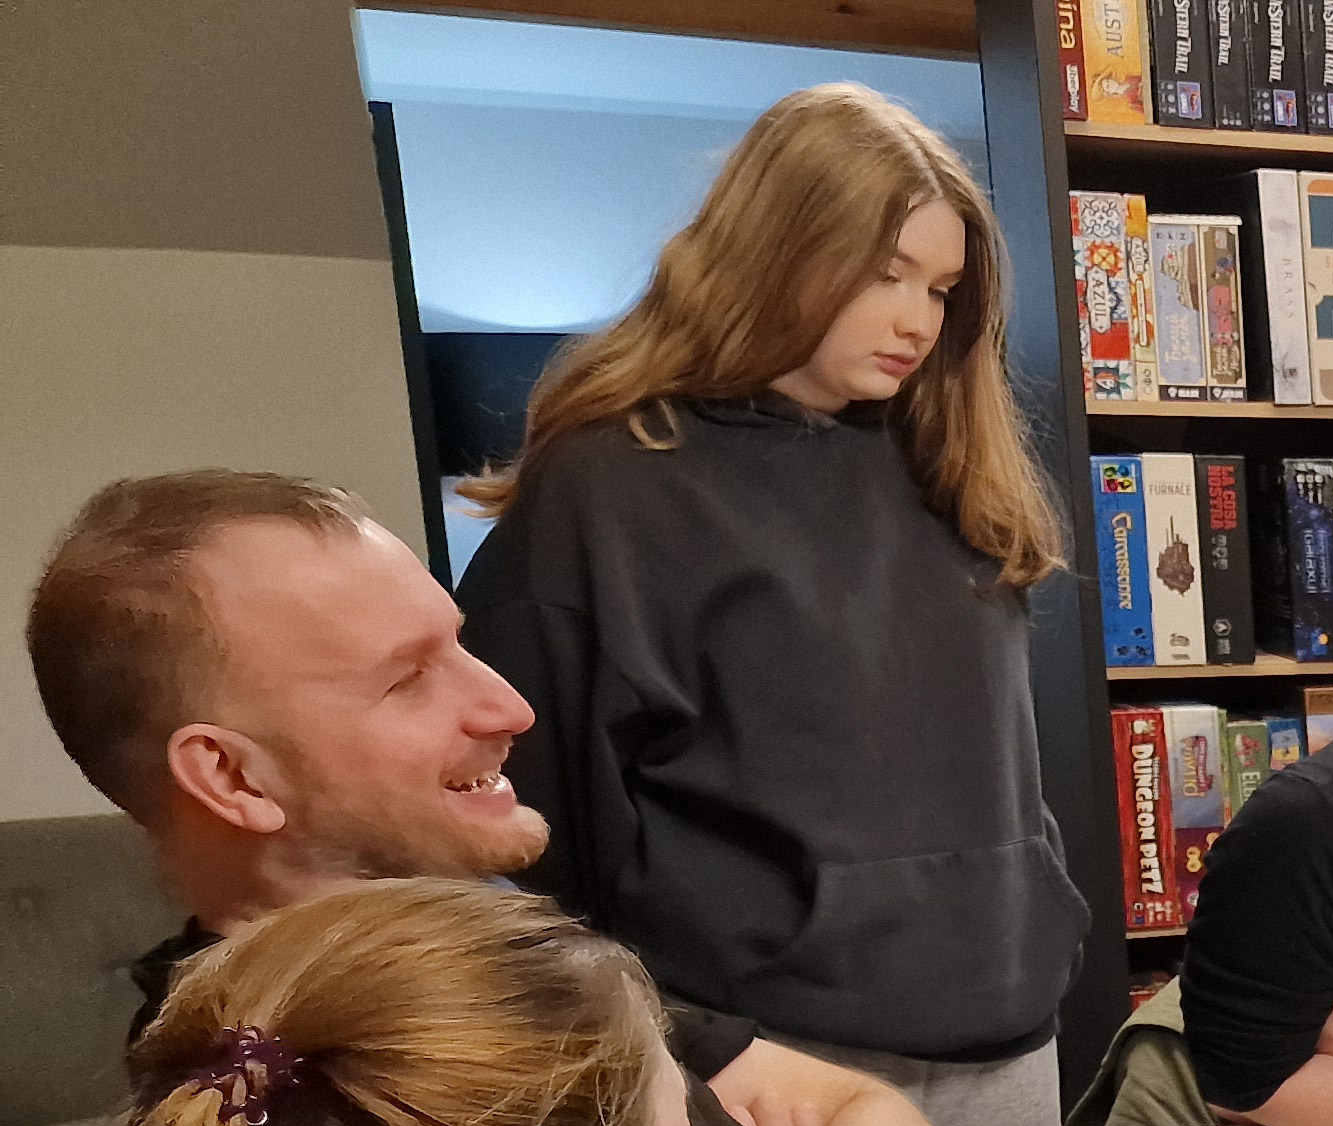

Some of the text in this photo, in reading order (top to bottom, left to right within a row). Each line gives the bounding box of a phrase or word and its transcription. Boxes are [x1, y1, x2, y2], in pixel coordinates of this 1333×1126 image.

[1057, 0, 1078, 49] ina
[1092, 278, 1107, 322] AZUL
[1149, 484, 1192, 496] FURNACE
[1131, 743, 1164, 894] DUNGEON PETZ
